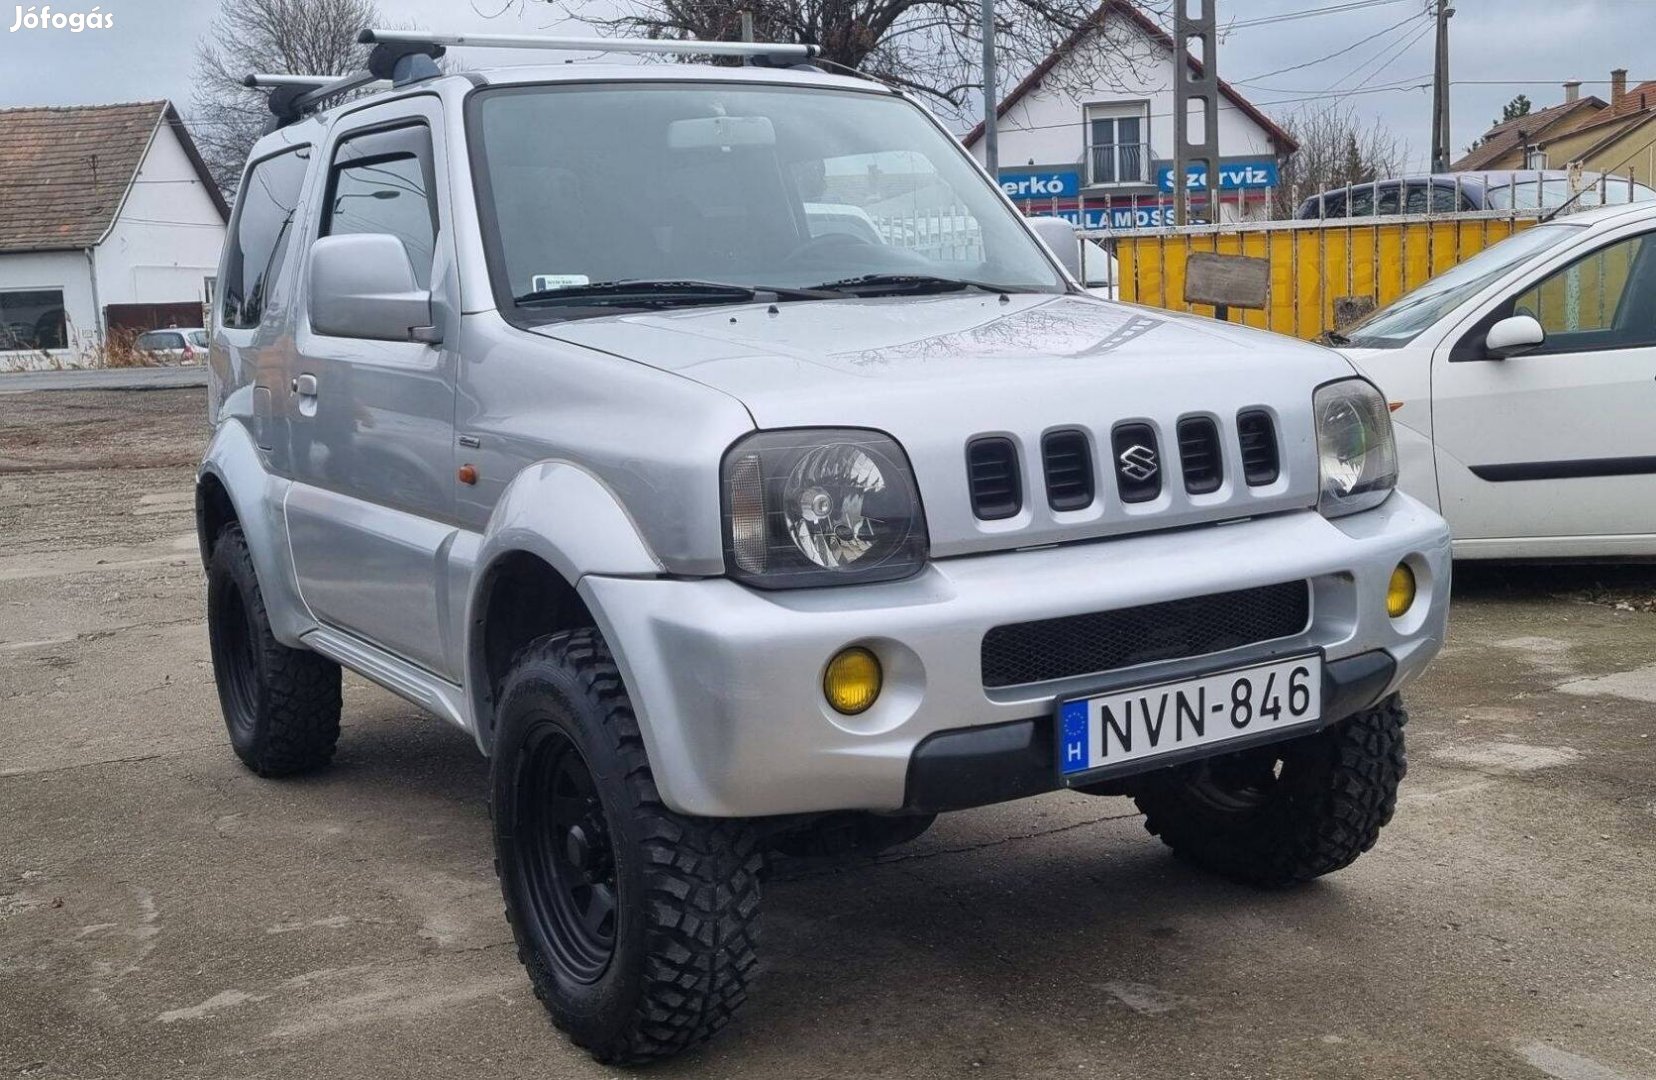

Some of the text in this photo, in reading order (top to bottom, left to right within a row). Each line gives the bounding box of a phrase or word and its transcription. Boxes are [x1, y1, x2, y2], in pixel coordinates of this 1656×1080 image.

[1002, 174, 1064, 195] erkó
[1101, 666, 1310, 758] NVN-846
[1067, 742, 1081, 762] H
